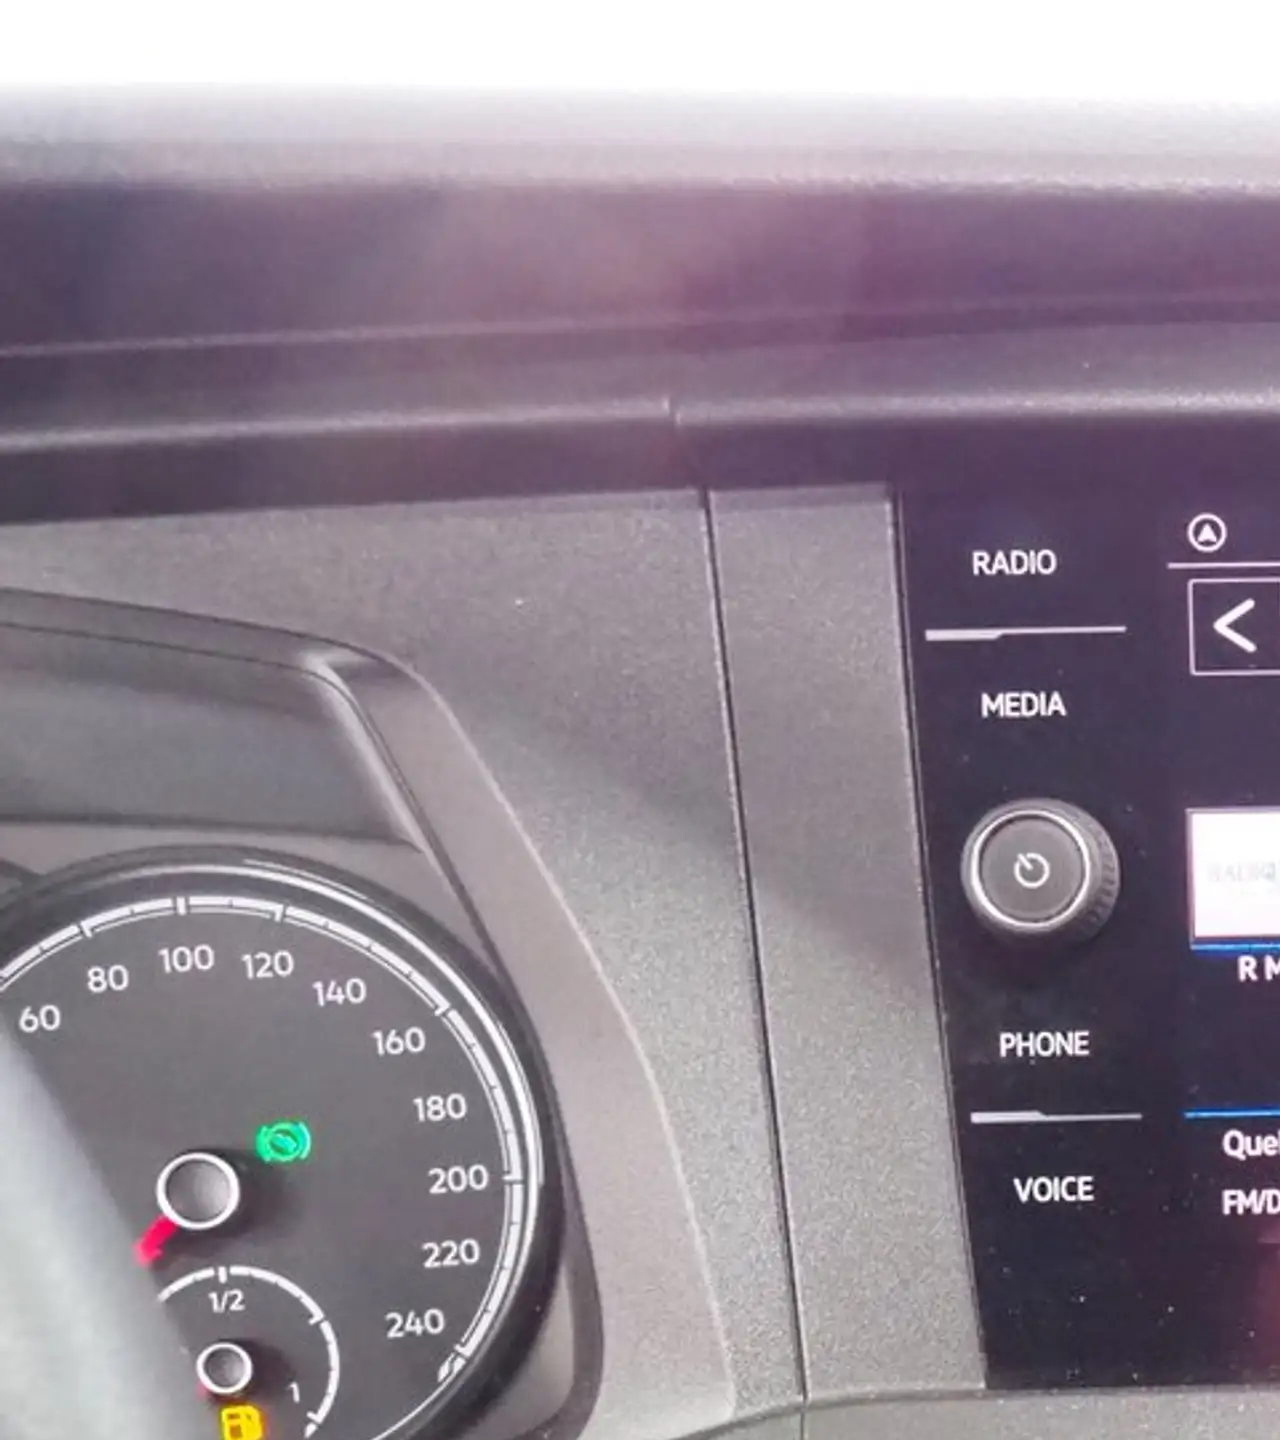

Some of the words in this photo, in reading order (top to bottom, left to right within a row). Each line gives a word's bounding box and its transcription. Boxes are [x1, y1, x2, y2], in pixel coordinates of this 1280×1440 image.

[972, 548, 1057, 576] RADIO
[981, 691, 1067, 718] MEDIA
[158, 944, 215, 973] 100
[242, 950, 295, 980] 120
[1237, 954, 1258, 982] R
[87, 964, 129, 993] 80
[312, 977, 367, 1007] 140
[19, 1004, 61, 1033] 60
[372, 1026, 426, 1056] 160
[999, 1030, 1090, 1058] PHONE
[413, 1093, 467, 1122] 180
[428, 1164, 489, 1194] 200
[1013, 1175, 1095, 1203] VOICE
[422, 1238, 480, 1269] 220
[208, 1288, 245, 1313] 1/2
[385, 1308, 445, 1339] 240
[286, 1381, 301, 1404] 1
